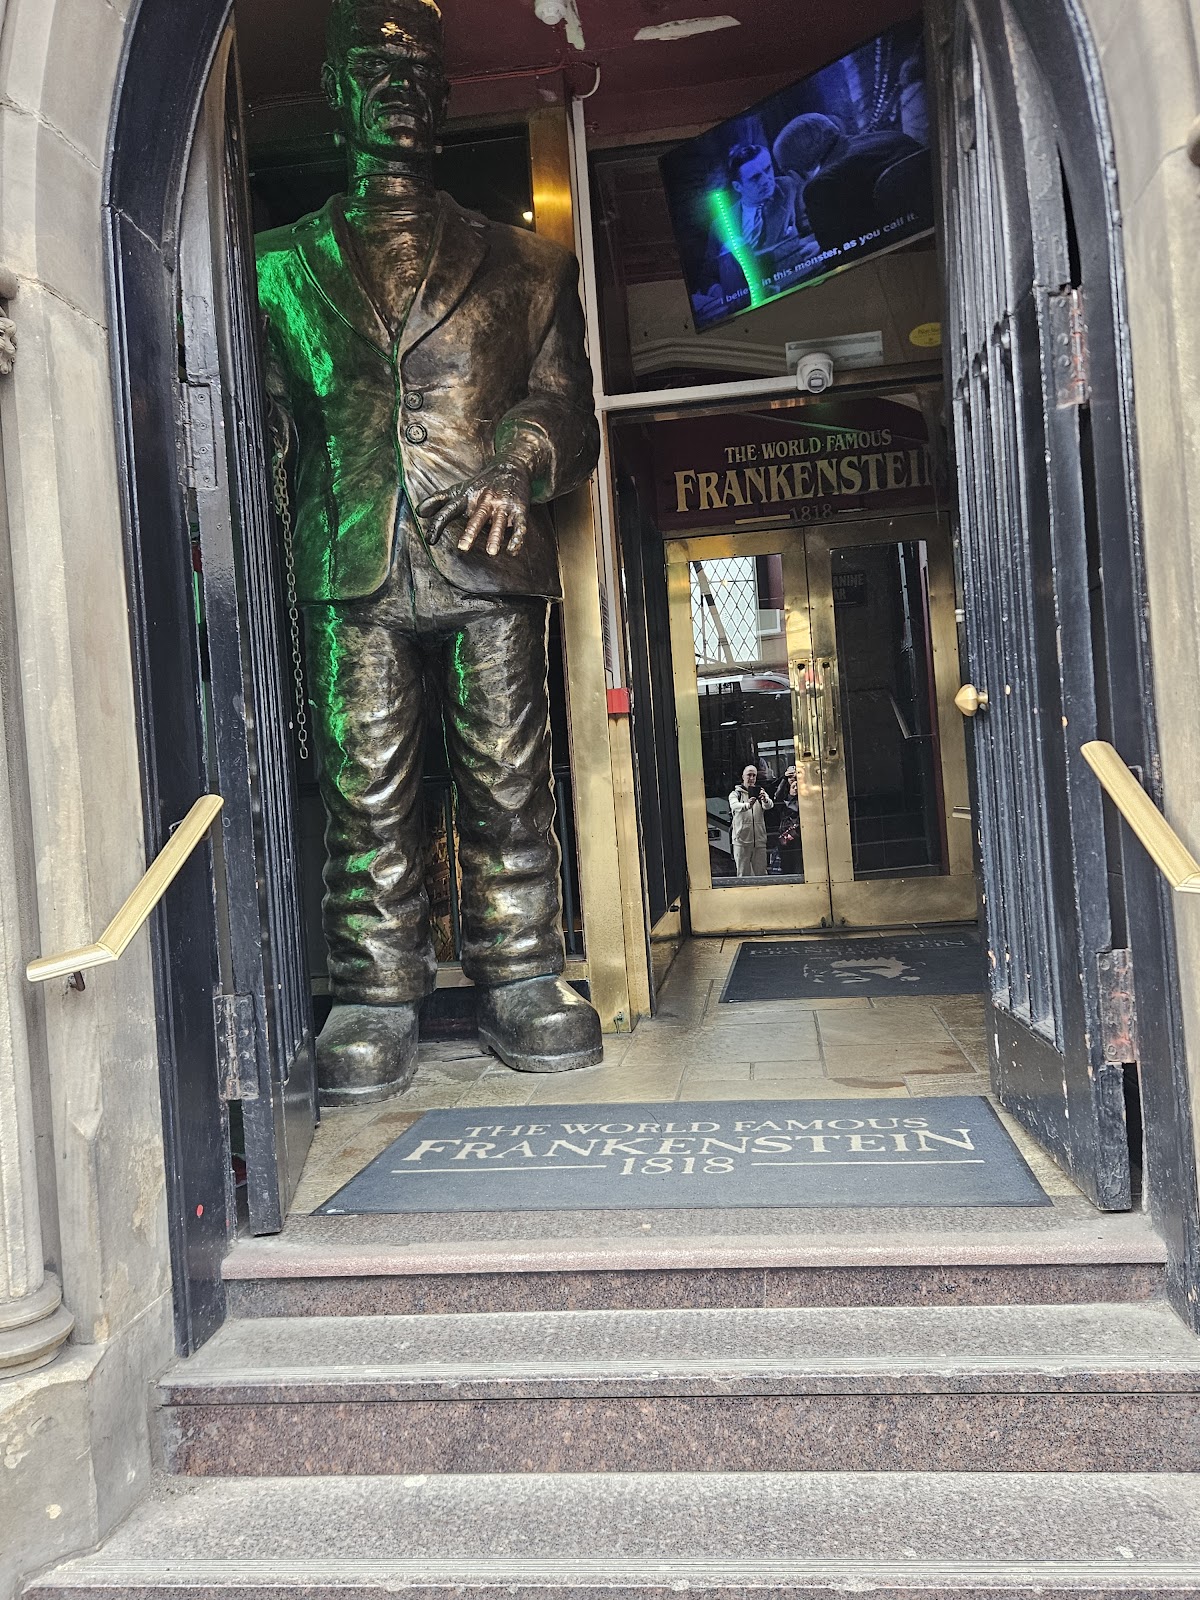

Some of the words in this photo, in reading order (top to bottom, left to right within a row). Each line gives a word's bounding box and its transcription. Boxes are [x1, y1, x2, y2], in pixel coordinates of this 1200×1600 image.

[761, 277, 772, 287] in
[773, 267, 793, 281] this
[794, 247, 842, 273] monster,
[842, 239, 857, 251] as
[858, 229, 881, 246] you
[882, 216, 905, 233] call
[725, 443, 757, 464] THE
[760, 437, 822, 460] WORLD
[826, 428, 893, 453] FAMOUS
[788, 503, 834, 523] 1818
[464, 1123, 552, 1138] THE
[559, 1121, 721, 1135] WORLD
[733, 1117, 929, 1132] FAMOUS
[401, 1128, 975, 1162] FRANKENSTEIN
[618, 1156, 735, 1176] 1818
